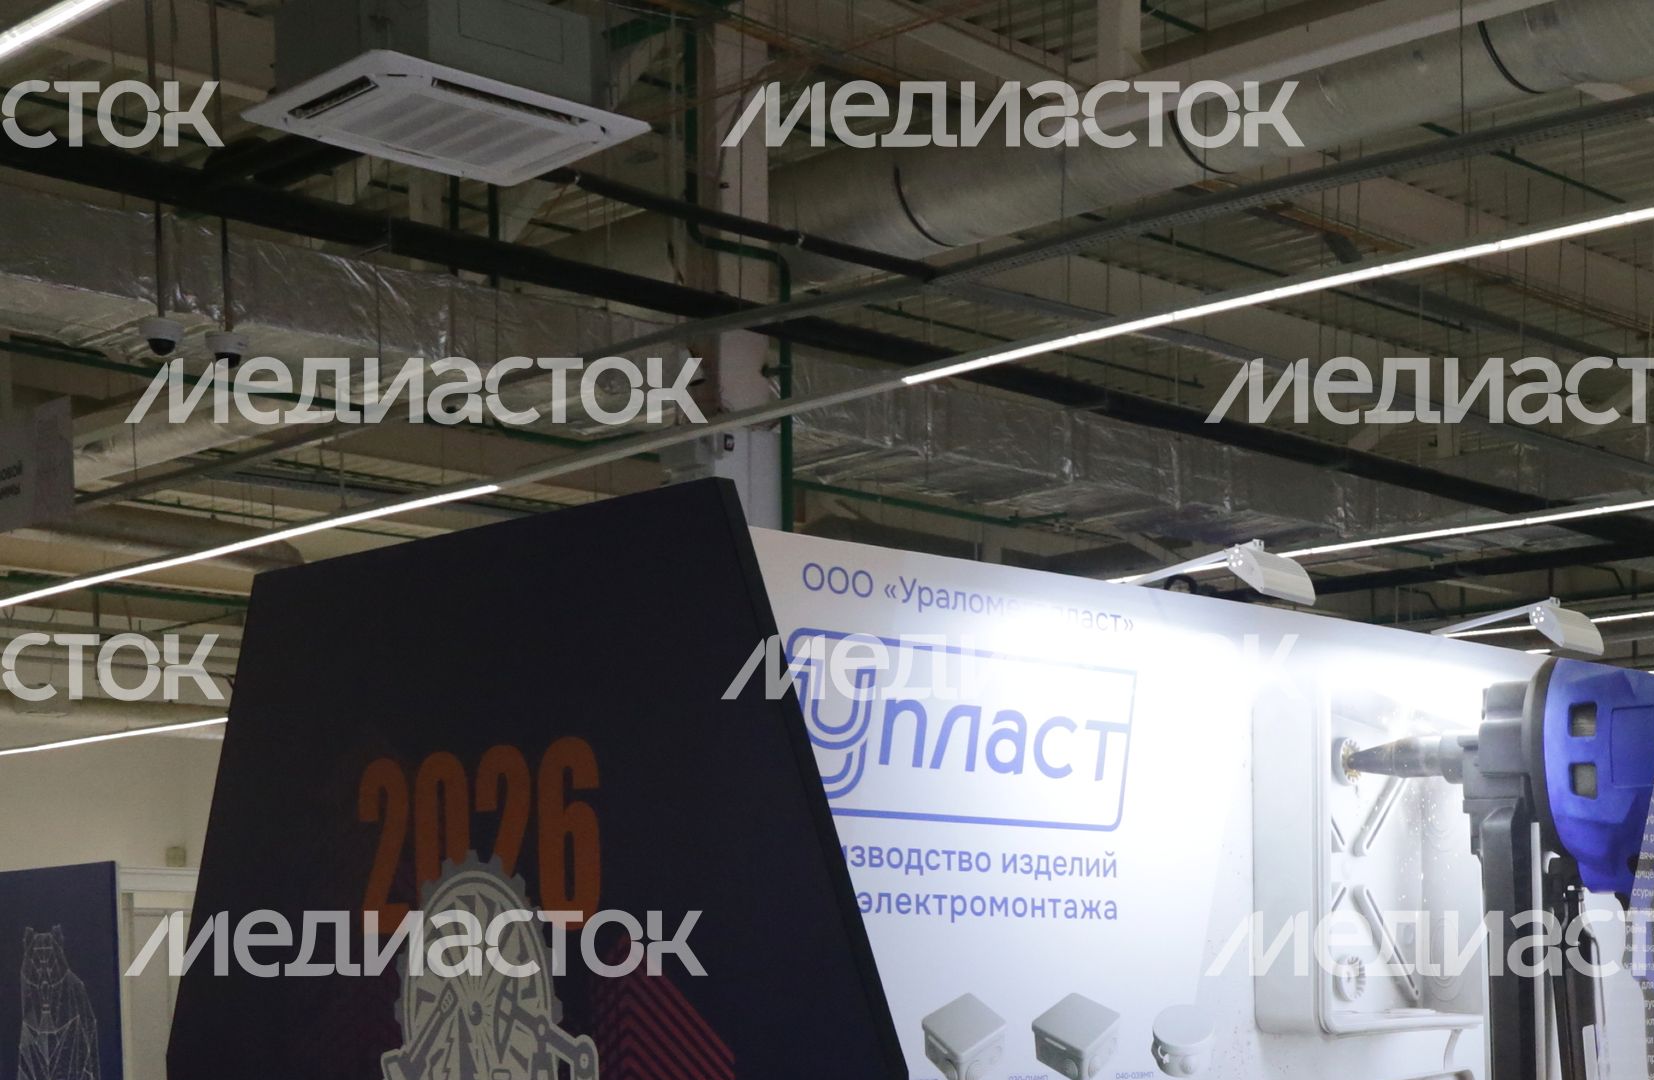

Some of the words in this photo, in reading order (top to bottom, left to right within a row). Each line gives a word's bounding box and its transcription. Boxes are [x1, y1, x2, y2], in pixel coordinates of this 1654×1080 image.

[802, 563, 874, 598] ООО
[358, 737, 601, 934] 2026
[1001, 850, 1118, 880] изделий
[857, 890, 1118, 923] электромонтажа
